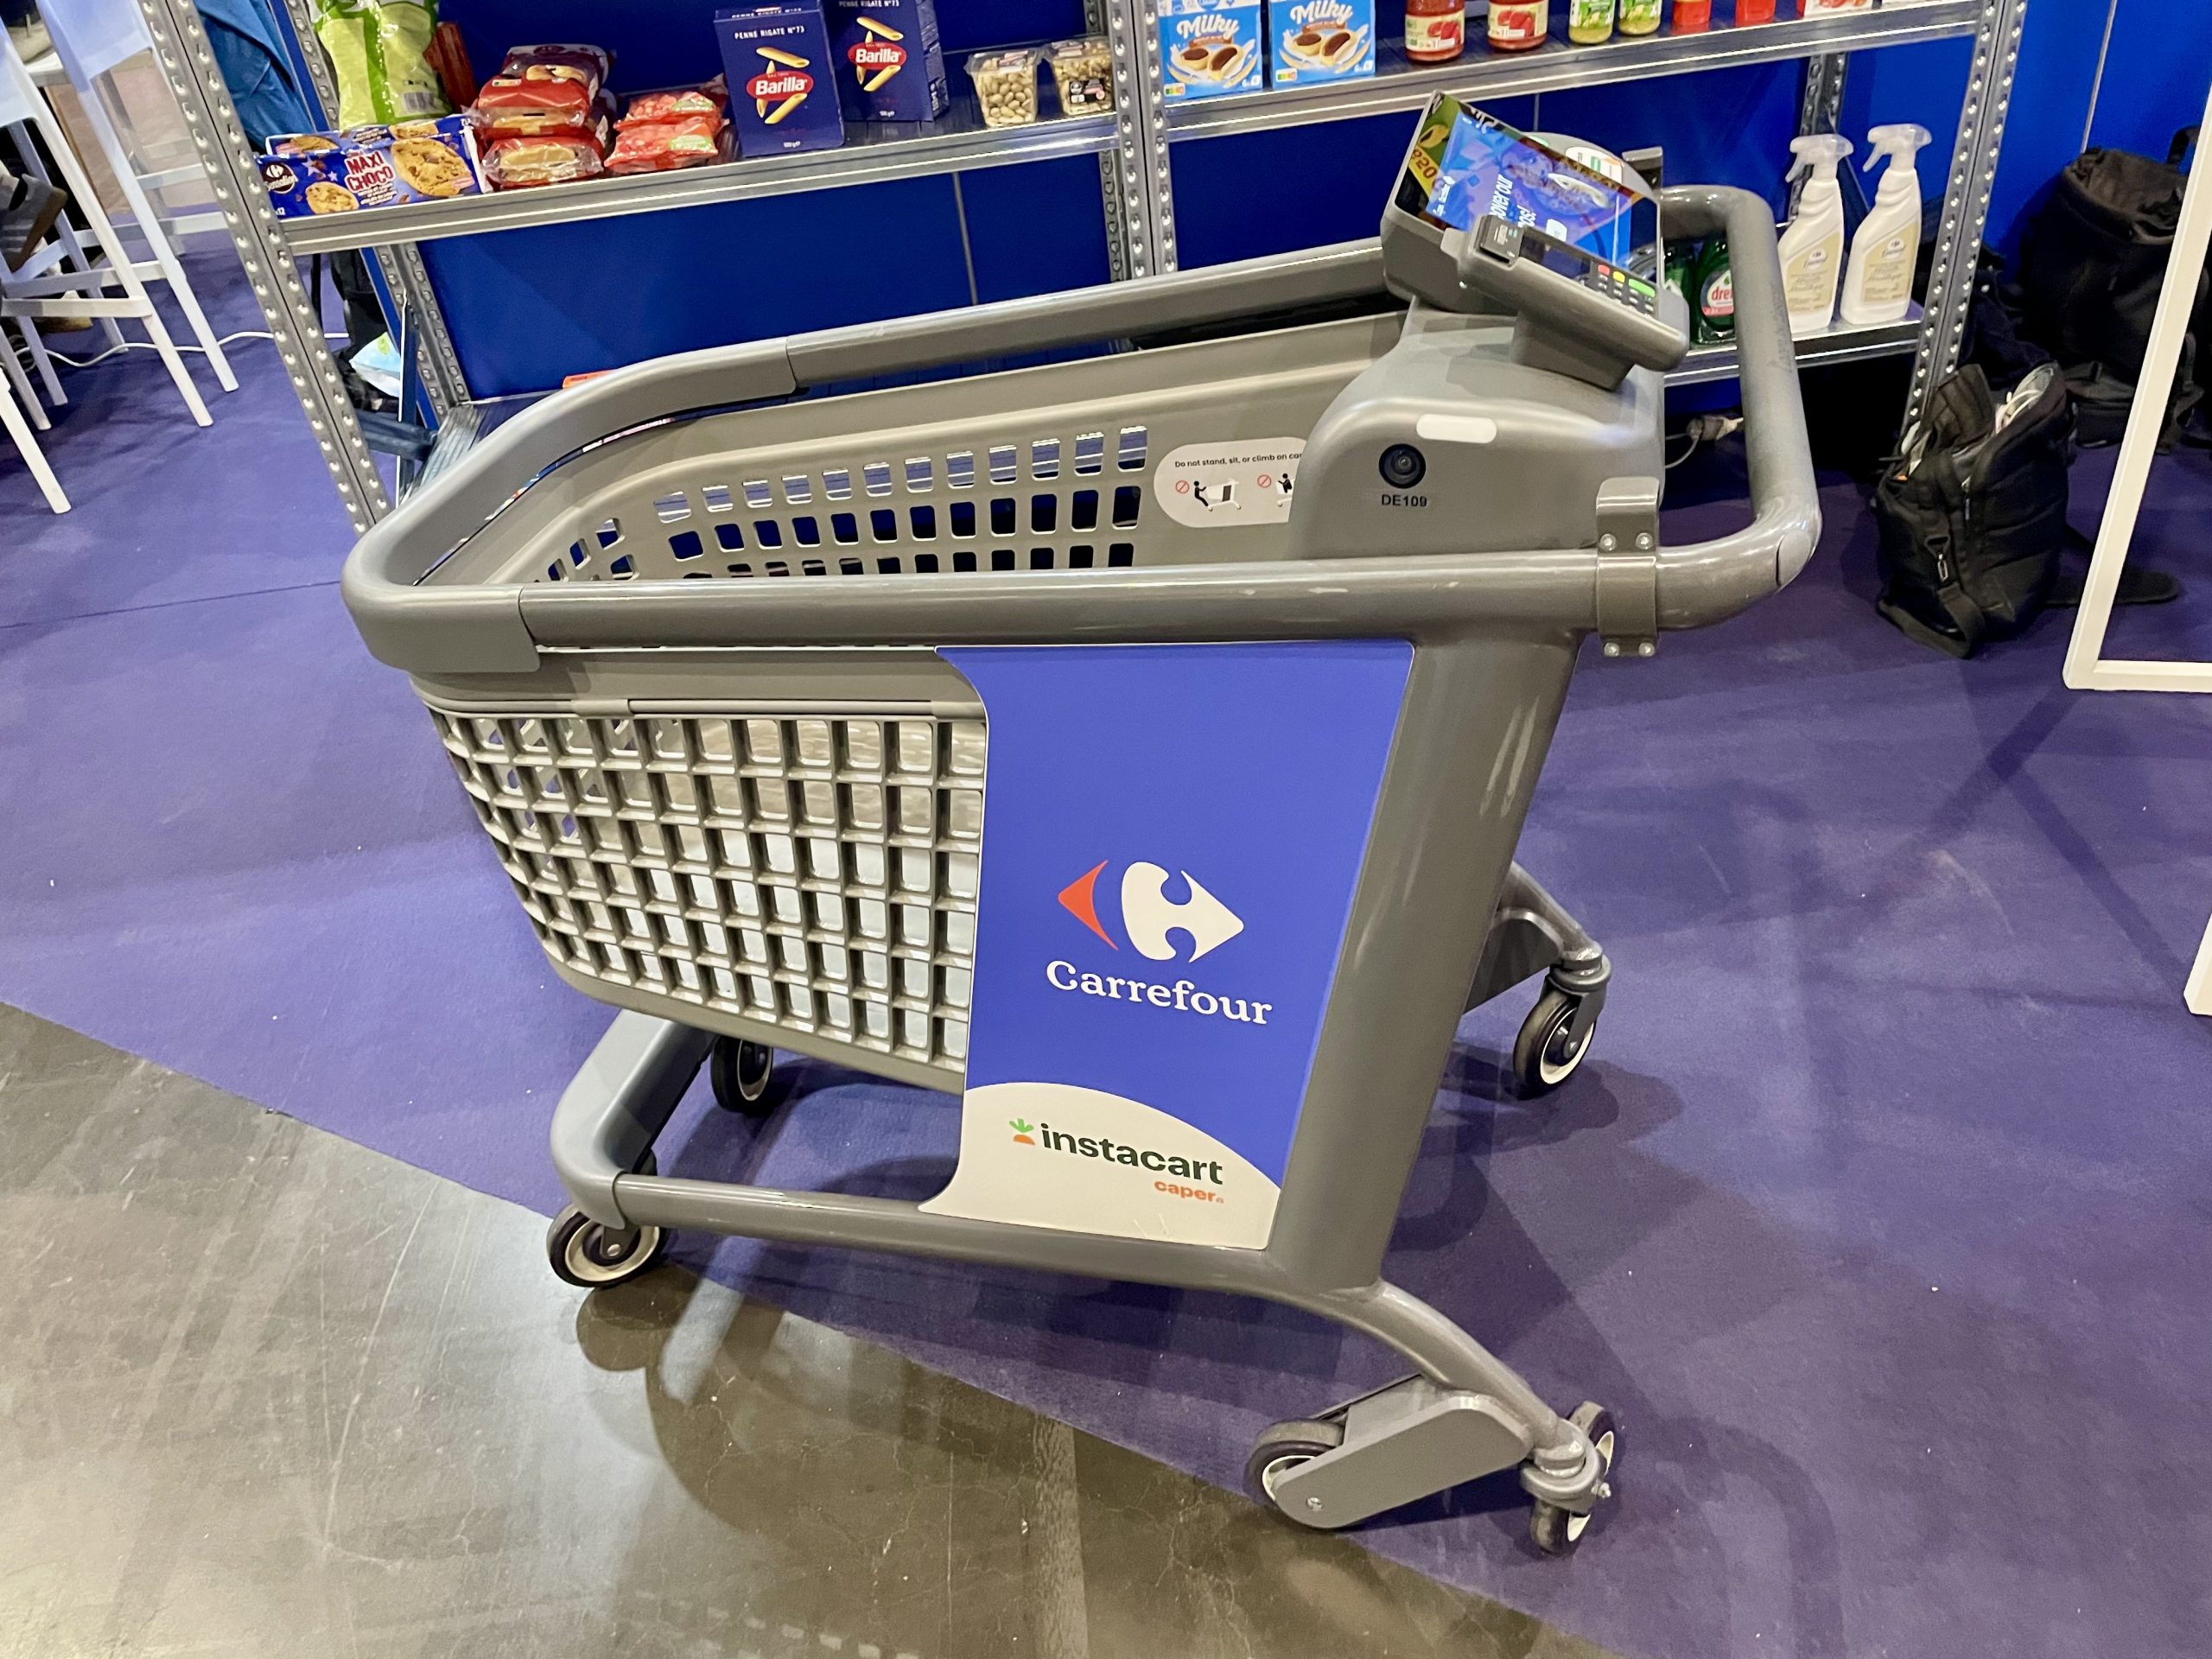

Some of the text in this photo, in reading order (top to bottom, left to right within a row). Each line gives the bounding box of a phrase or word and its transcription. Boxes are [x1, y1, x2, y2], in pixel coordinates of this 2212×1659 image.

[1290, 0, 1353, 24] Milky
[734, 30, 758, 40] PENNE
[760, 28, 785, 37] RIGATE
[1176, 14, 1239, 39] Milky
[855, 49, 899, 64] Barilla
[755, 76, 806, 96] Barilla
[346, 151, 384, 175] MAXI
[346, 166, 394, 192] CHOCO
[1711, 286, 1733, 301] dre
[1252, 454, 1275, 462] climb
[1382, 493, 1427, 507] DE109
[1046, 960, 1273, 1025] Carrefour
[1040, 1122, 1224, 1185] instacart
[1154, 1181, 1216, 1202] caper
